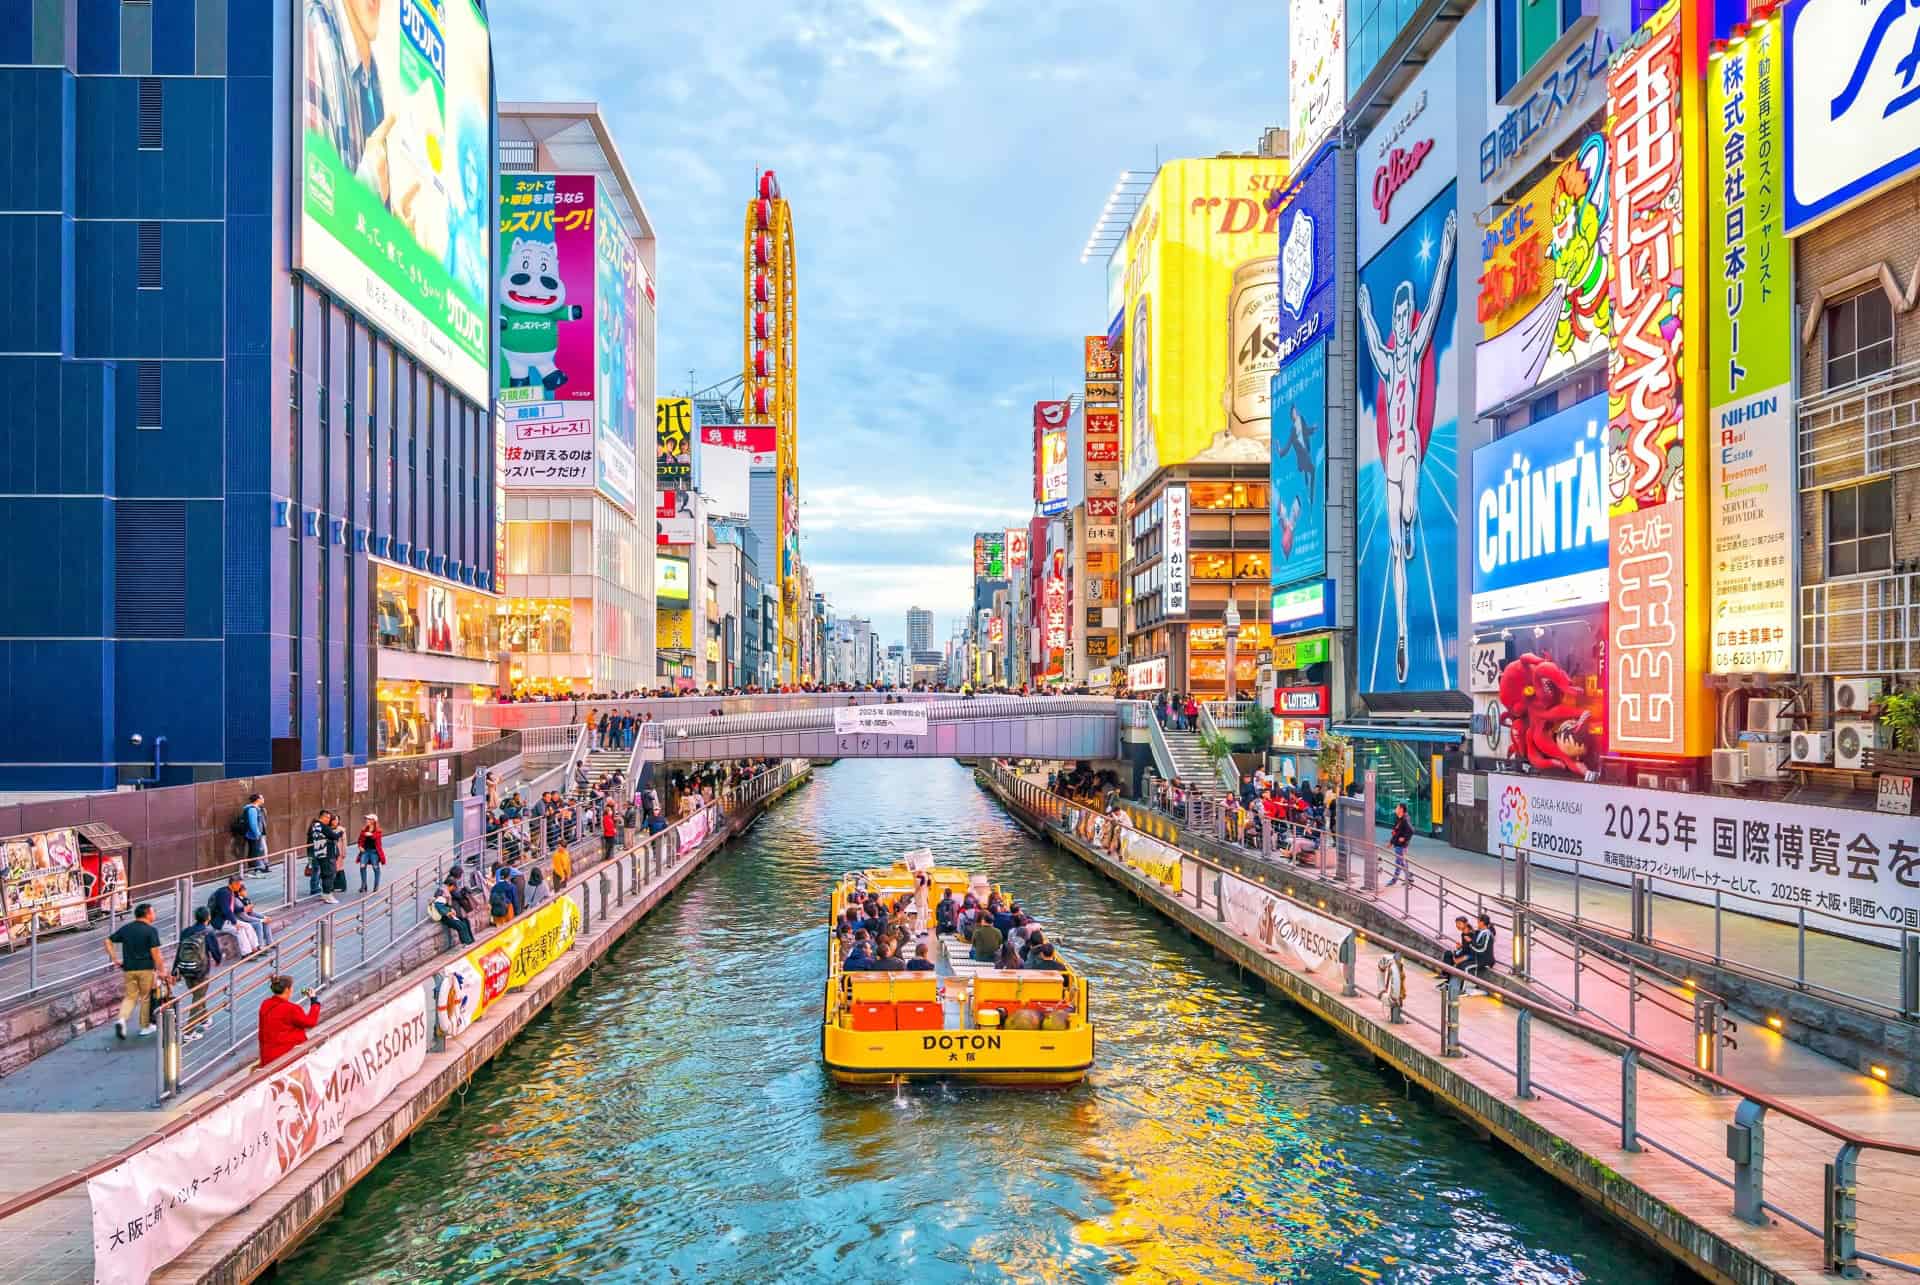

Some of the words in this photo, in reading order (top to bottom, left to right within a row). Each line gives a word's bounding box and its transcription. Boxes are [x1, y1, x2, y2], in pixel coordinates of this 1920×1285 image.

[1480, 27, 1616, 184] 日商エステム
[1757, 32, 1773, 304] 不動産再生のスペシャリスト
[516, 180, 556, 191] ネットで
[1371, 137, 1435, 224] Glico
[1481, 203, 1534, 261] かぜに
[1722, 54, 1747, 393] 株式会社日本リート
[1477, 231, 1542, 324] 改源
[1396, 373, 1408, 455] グリコ
[1721, 396, 1777, 429] NIHON
[524, 422, 583, 437] オートレース!
[1722, 429, 1746, 447] Real
[505, 446, 592, 461] 技が買えるのは
[1722, 448, 1753, 464] Estate
[1722, 463, 1768, 482] Investment
[1722, 498, 1757, 513] SERVICE
[1722, 509, 1765, 526] PROVIDER
[1618, 515, 1673, 554] スーパー
[1170, 552, 1183, 608] かに道楽
[1717, 626, 1784, 647] 広告主募集中
[1286, 692, 1318, 710] LOTTERIA
[1880, 776, 1911, 797] BAR
[1531, 795, 1583, 815] OSAKA-KANSAI
[1531, 814, 1553, 827] JAPAN
[1531, 831, 1583, 857] EXPO2025
[1604, 802, 1698, 852] 2025年
[1713, 816, 1920, 888] 国際博覧会を
[1603, 850, 1761, 896] 南海電鉄はオフィシャルパートナーとして、
[1771, 882, 1813, 904] 2025年
[1815, 892, 1920, 928] 大阪・関西への国
[923, 1035, 1001, 1050] DOTON
[322, 1055, 365, 1111] MGM
[361, 1011, 426, 1081] RESORTS
[948, 1052, 976, 1063] 大阪
